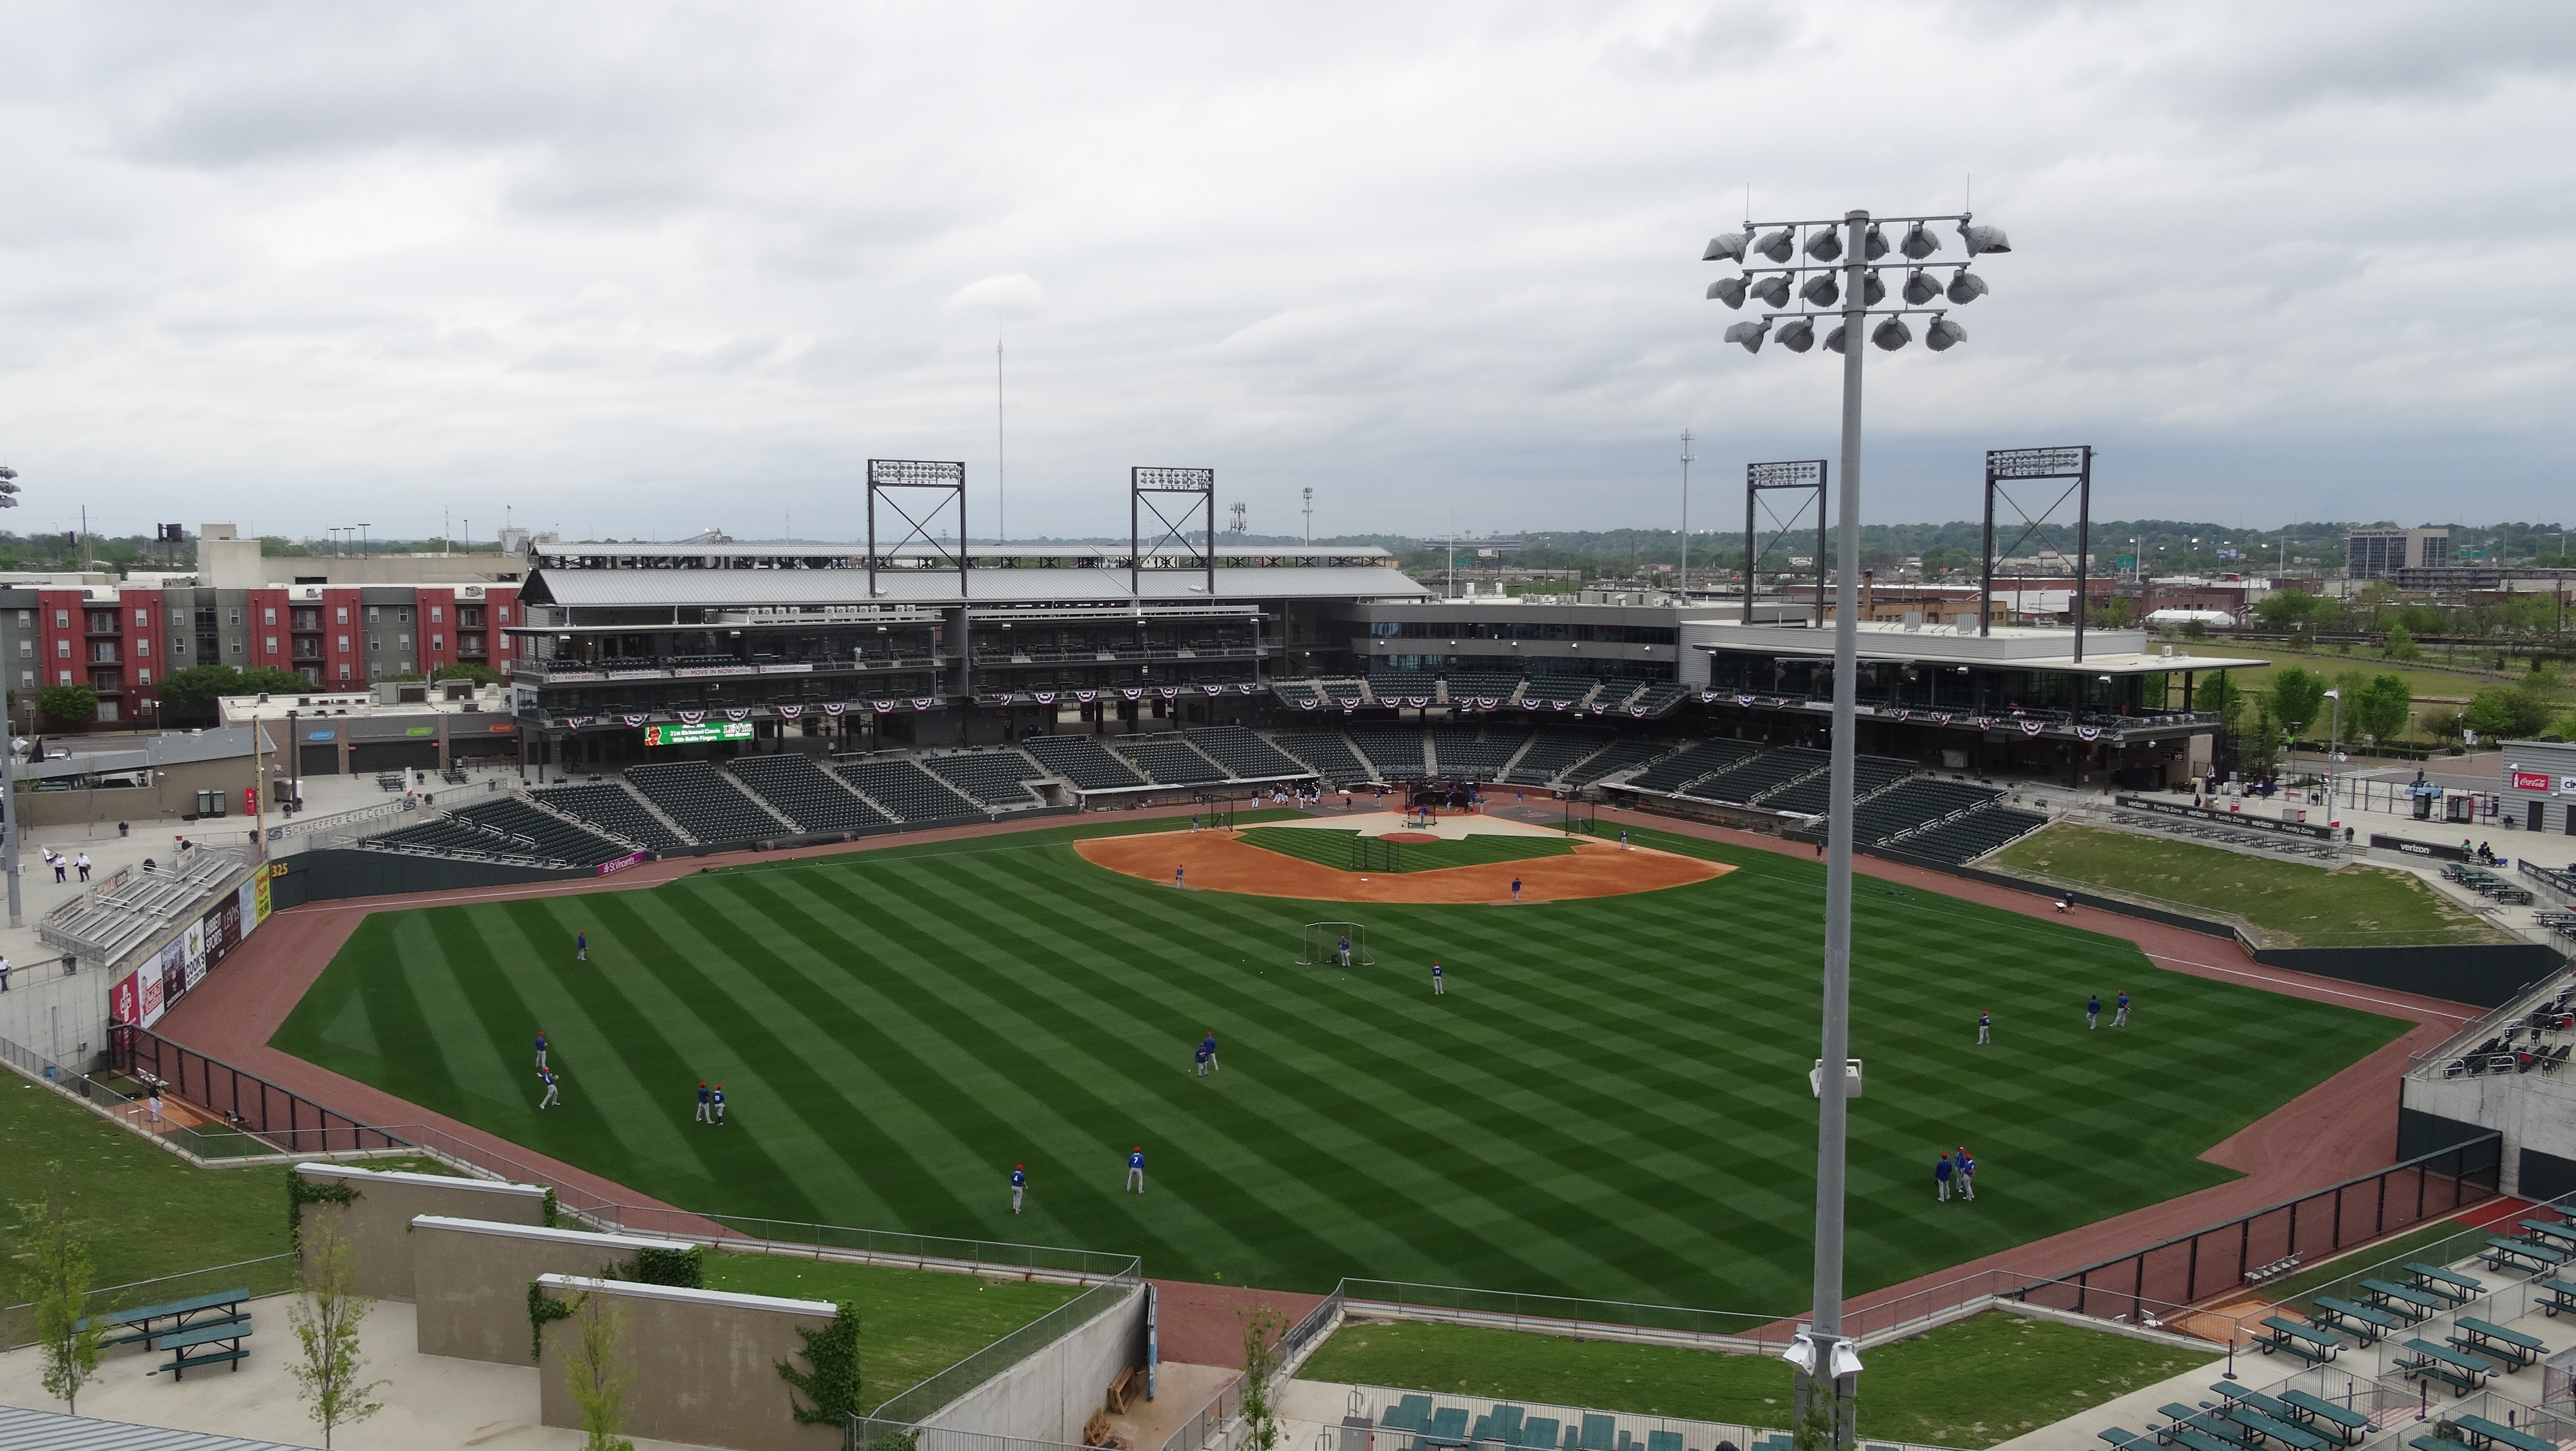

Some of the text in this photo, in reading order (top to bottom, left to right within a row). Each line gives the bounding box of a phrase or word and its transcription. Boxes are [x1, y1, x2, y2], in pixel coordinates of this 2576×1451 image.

[2127, 801, 2148, 809] verizon
[2153, 804, 2169, 812] Family
[2187, 809, 2209, 818] verizon
[2215, 813, 2232, 822] Family
[2251, 820, 2274, 829] verizon
[2282, 824, 2300, 834] Family
[2400, 843, 2429, 854] verizon
[272, 863, 288, 878] 325
[205, 911, 222, 938] HIBBETT
[206, 928, 223, 953] SPORTS
[186, 951, 205, 978] COOK'S
